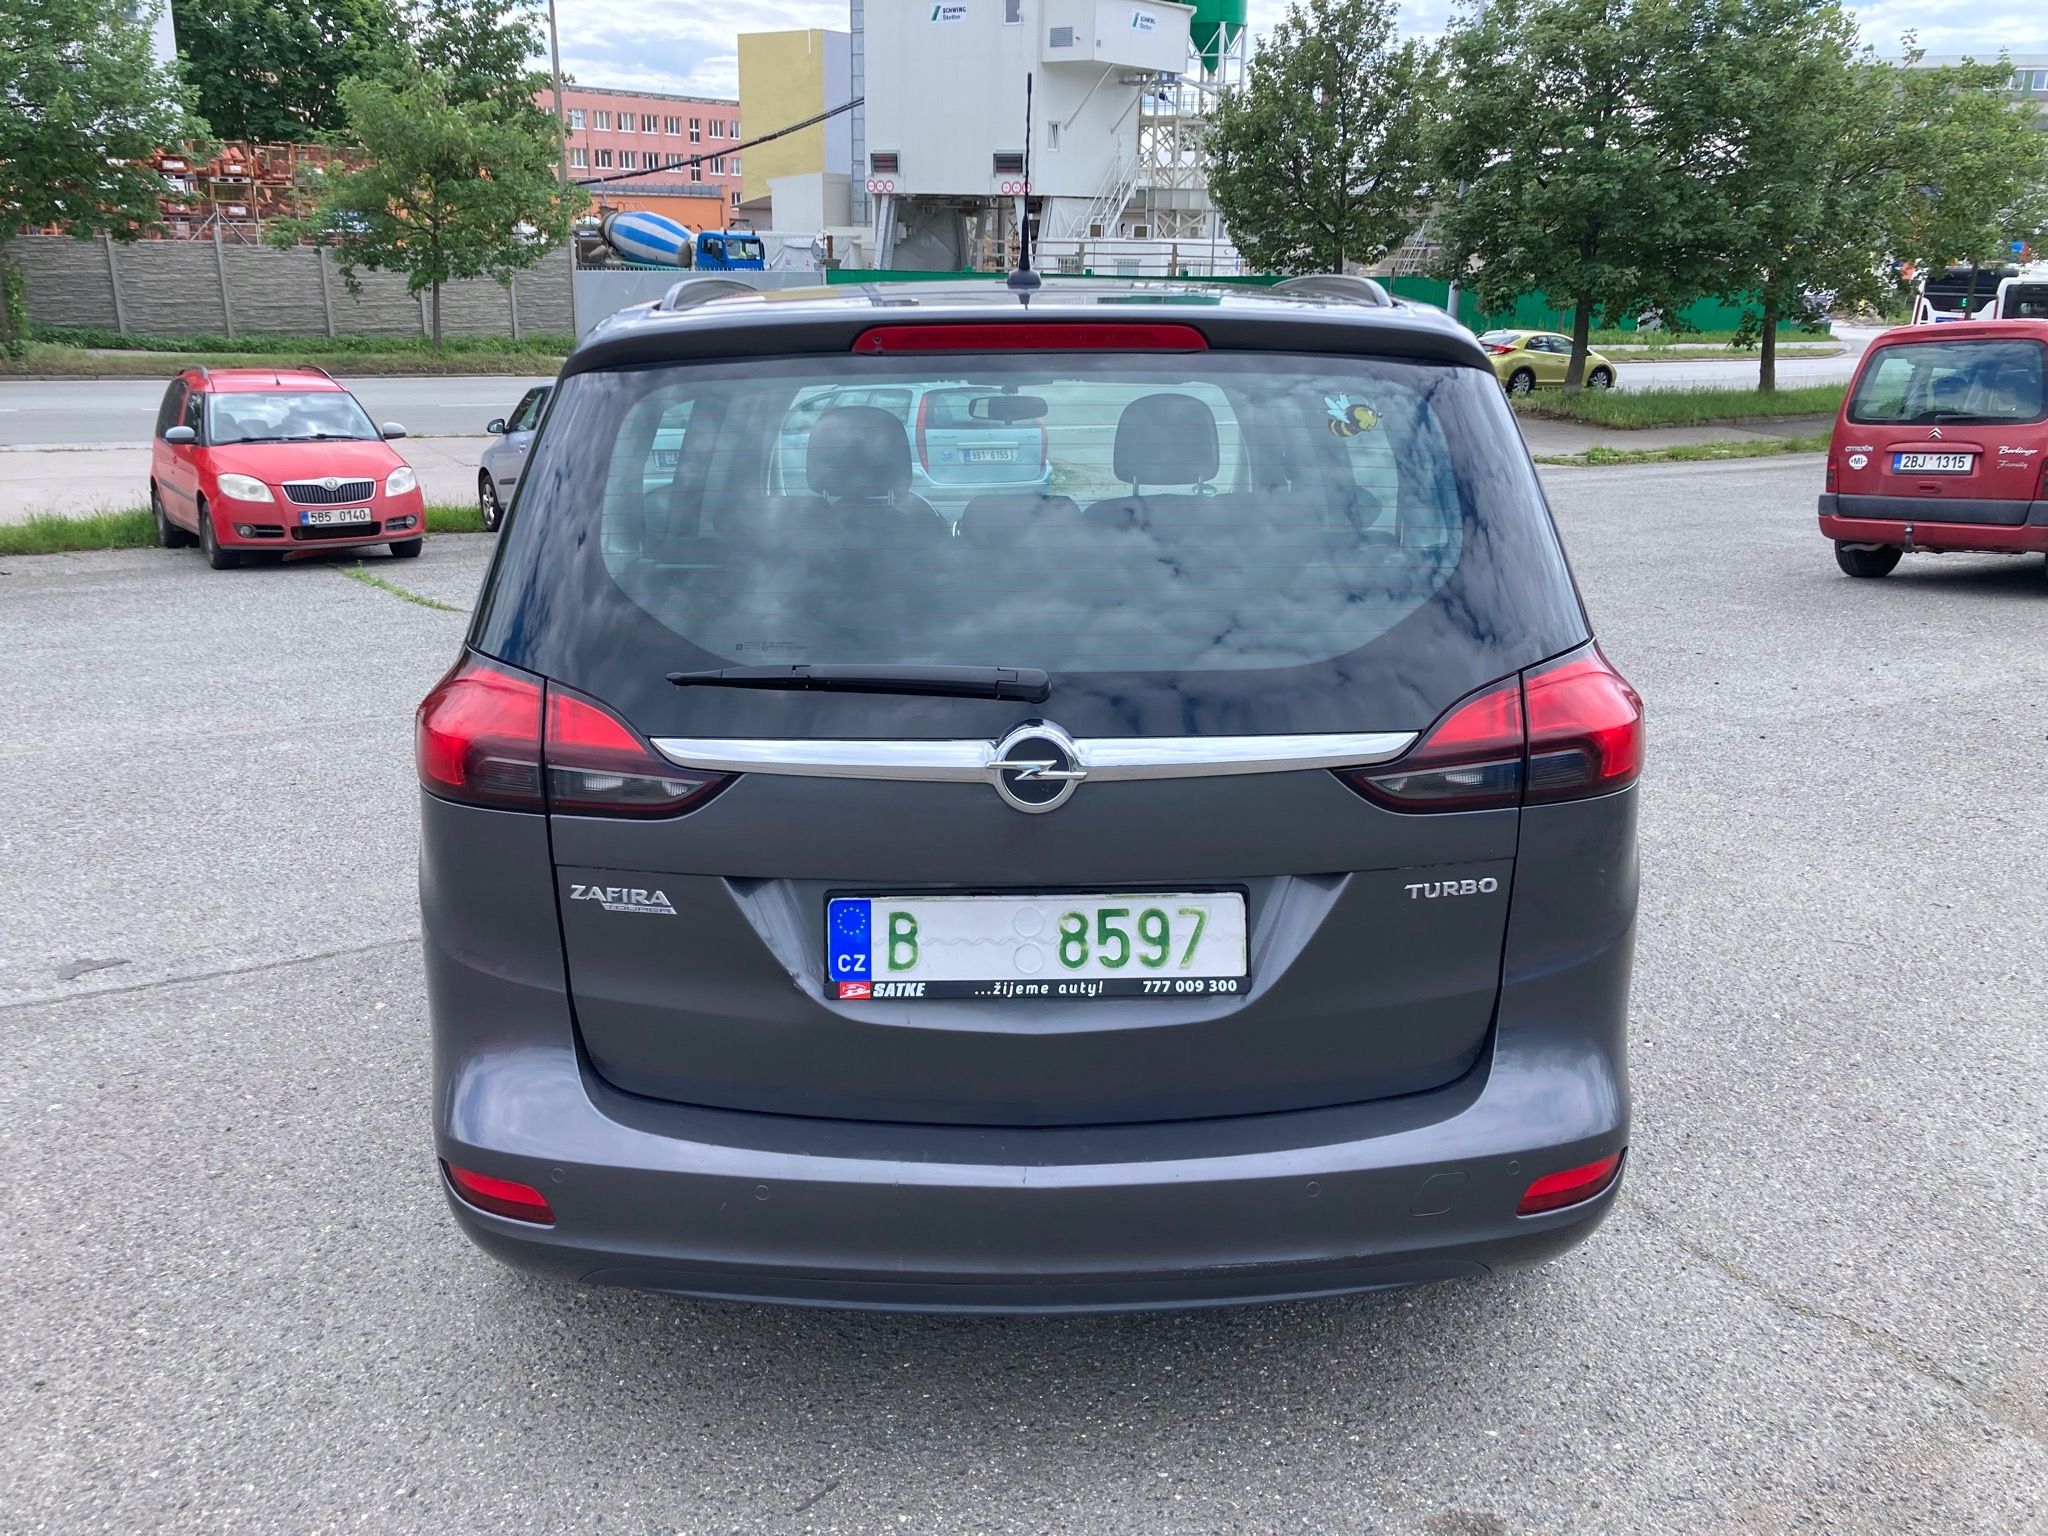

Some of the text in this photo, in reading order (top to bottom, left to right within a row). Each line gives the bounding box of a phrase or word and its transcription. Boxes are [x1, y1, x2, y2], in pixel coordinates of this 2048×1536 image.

[972, 450, 1009, 460] 9B1 6155
[1998, 445, 2038, 457] Berlingo
[1903, 455, 1967, 469] 2BJ 1315
[310, 512, 332, 523] 5B5
[339, 510, 366, 521] 0140
[569, 884, 672, 906] ZAFIRA
[1403, 877, 1498, 899] TURBO
[888, 907, 1209, 972] B 8597
[837, 954, 867, 972] CZ
[872, 982, 927, 998] SATKE
[973, 980, 1104, 998] ...žijeme auty!
[1142, 979, 1238, 993] 777 009 300
